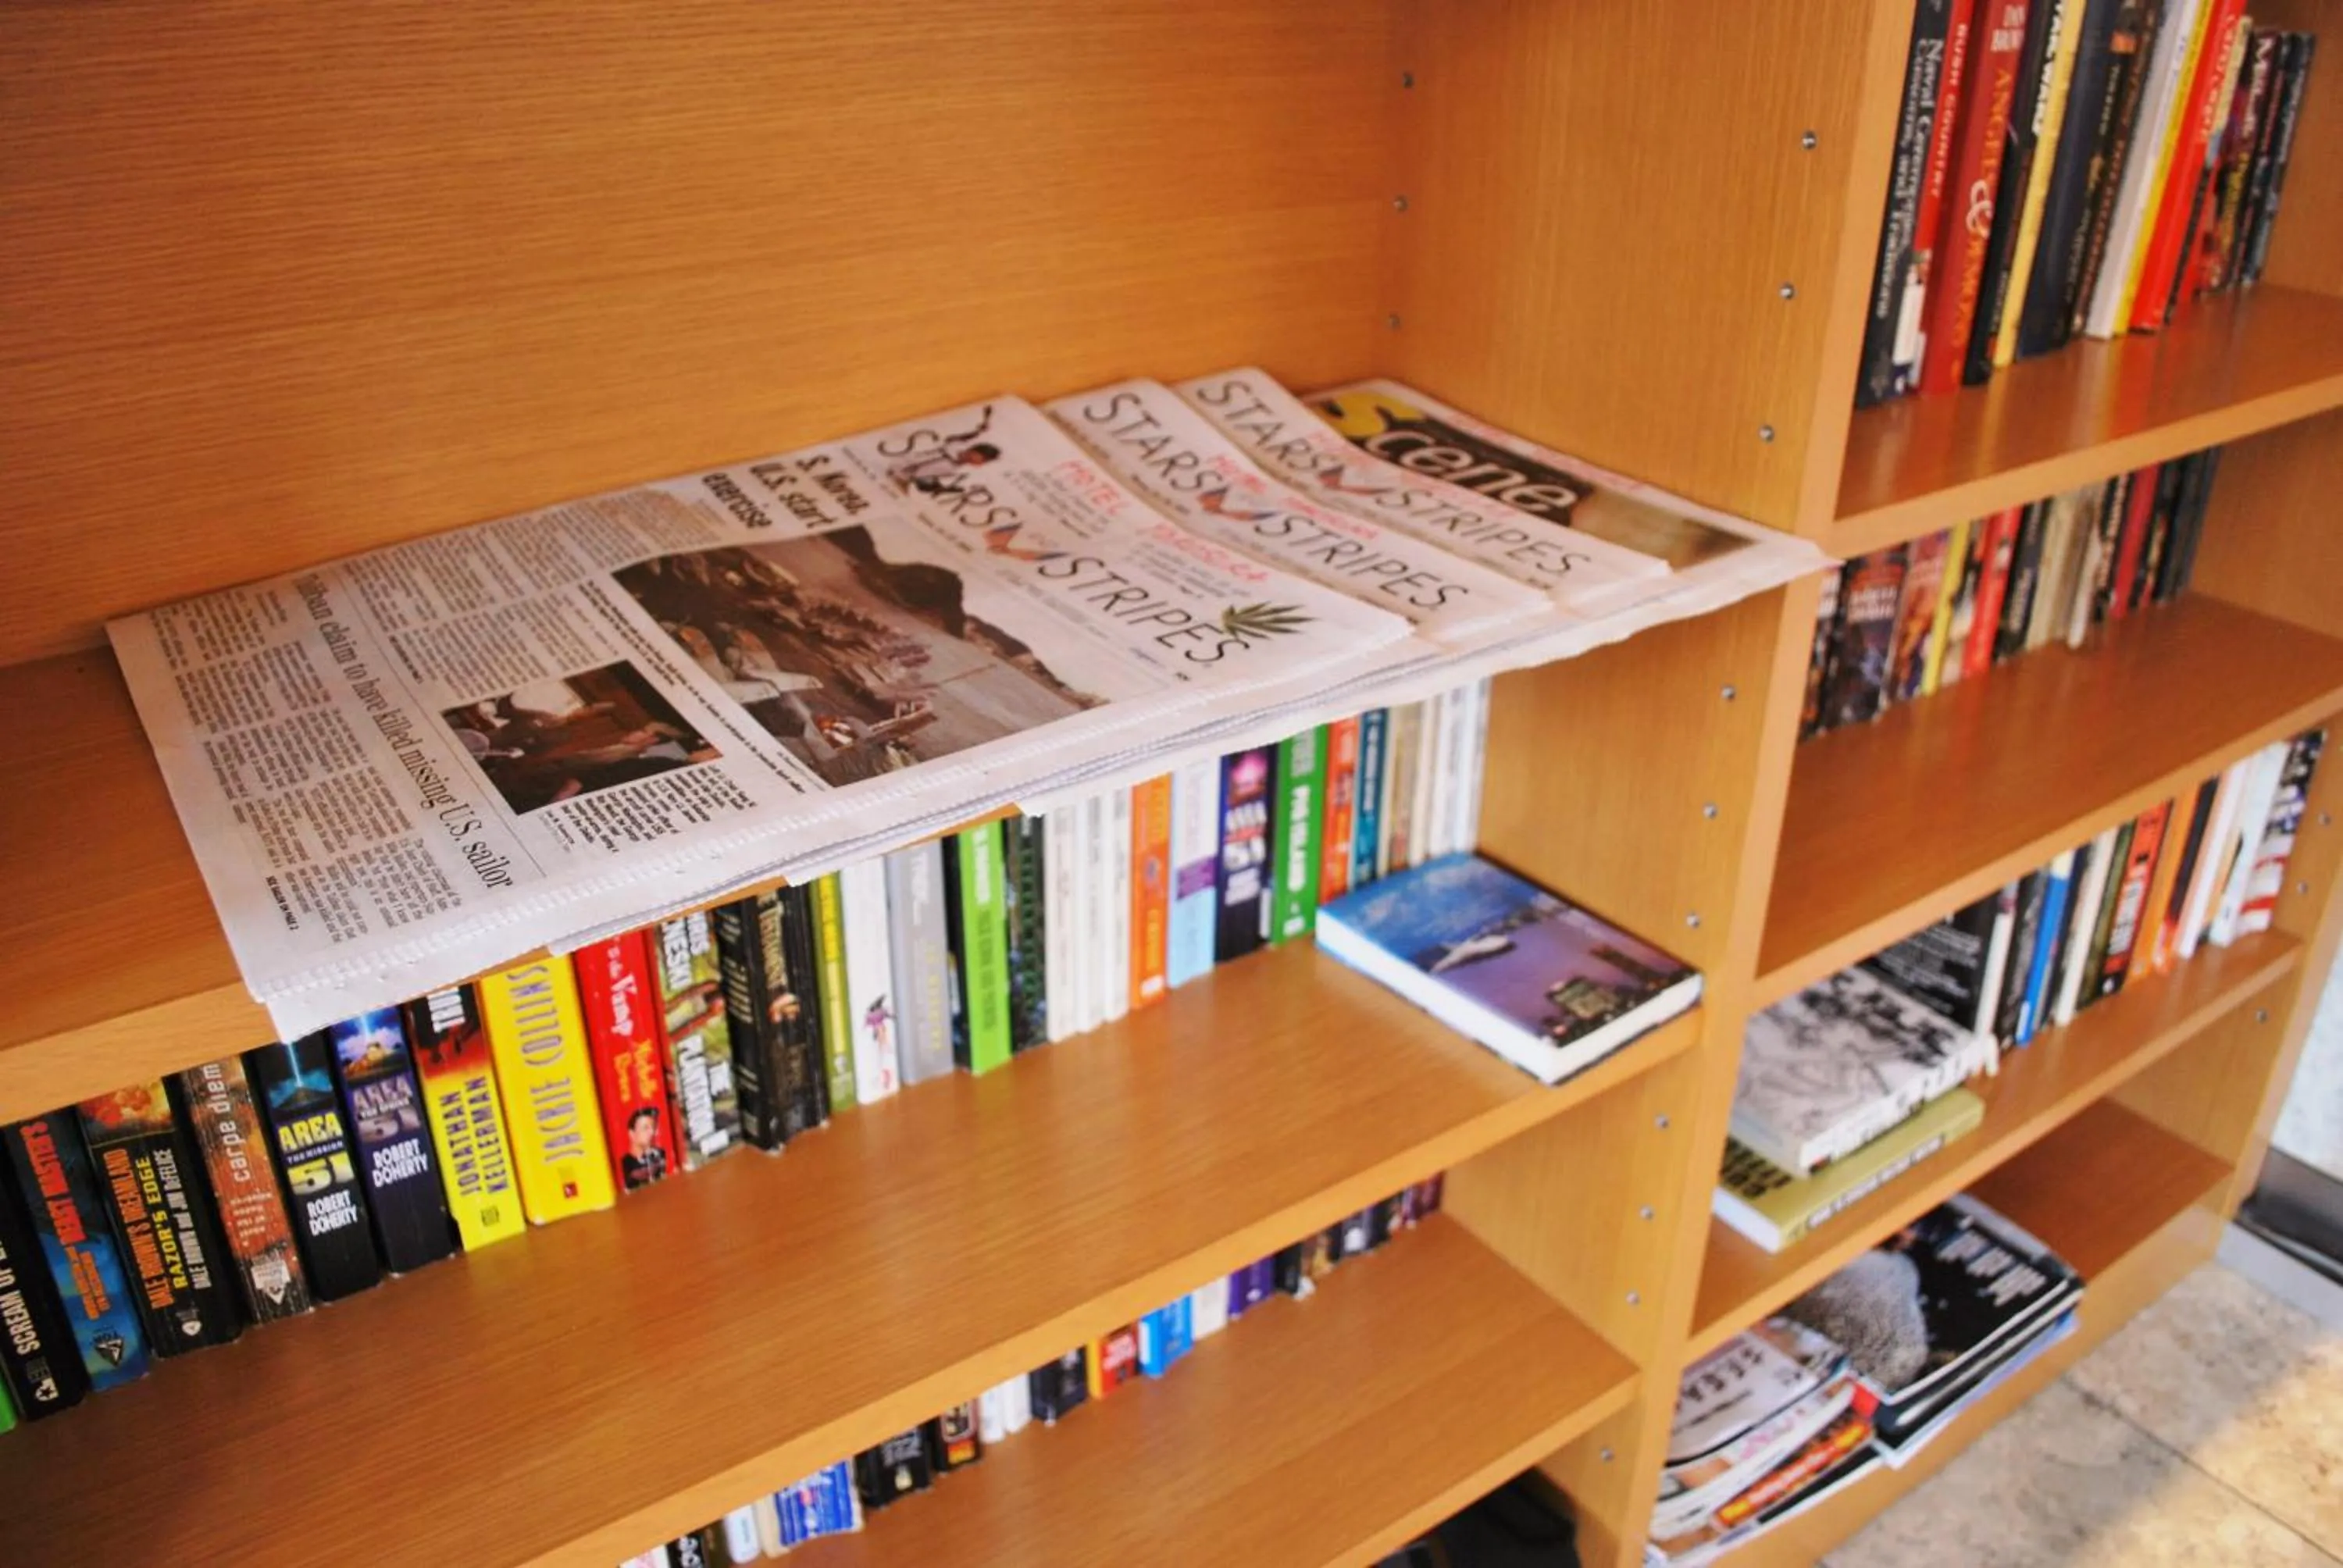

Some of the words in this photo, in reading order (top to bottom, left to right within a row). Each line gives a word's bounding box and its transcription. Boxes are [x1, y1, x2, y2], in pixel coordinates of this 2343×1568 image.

[1920, 37, 1943, 109] Naval
[1083, 391, 1225, 501] STARS
[1254, 512, 1470, 612] STRIPES
[1196, 380, 1334, 480] STARS
[1375, 484, 1593, 578] STRIPES
[1037, 554, 1250, 667] STRIPES
[319, 622, 358, 665] claim
[343, 663, 368, 681] to
[351, 676, 389, 712] have
[372, 707, 423, 752] killed
[398, 749, 458, 810] missing
[438, 802, 483, 843] U.S.
[462, 840, 514, 889] sailor
[505, 964, 565, 1069] COLLINS
[610, 973, 638, 1037] Vamp
[202, 1063, 232, 1115] diem
[352, 1074, 414, 1114] AREA
[276, 1111, 344, 1153] AREA
[358, 1103, 423, 1143] 51
[438, 1089, 483, 1197] JONATHAN
[463, 1075, 510, 1195] KELLERMAN
[528, 1075, 586, 1165] JACKIE
[219, 1119, 251, 1184] carpe
[287, 1151, 355, 1196] 51
[308, 1140, 344, 1160] MISSION
[372, 1138, 420, 1169] ROBERT
[372, 1153, 430, 1188] DOHERTY
[134, 1156, 162, 1205] EDGE
[306, 1189, 351, 1221] ROBERT
[308, 1205, 358, 1236] DOHERTY
[152, 1210, 190, 1290] RAZOR'S
[0, 1288, 41, 1356] SCREAM
